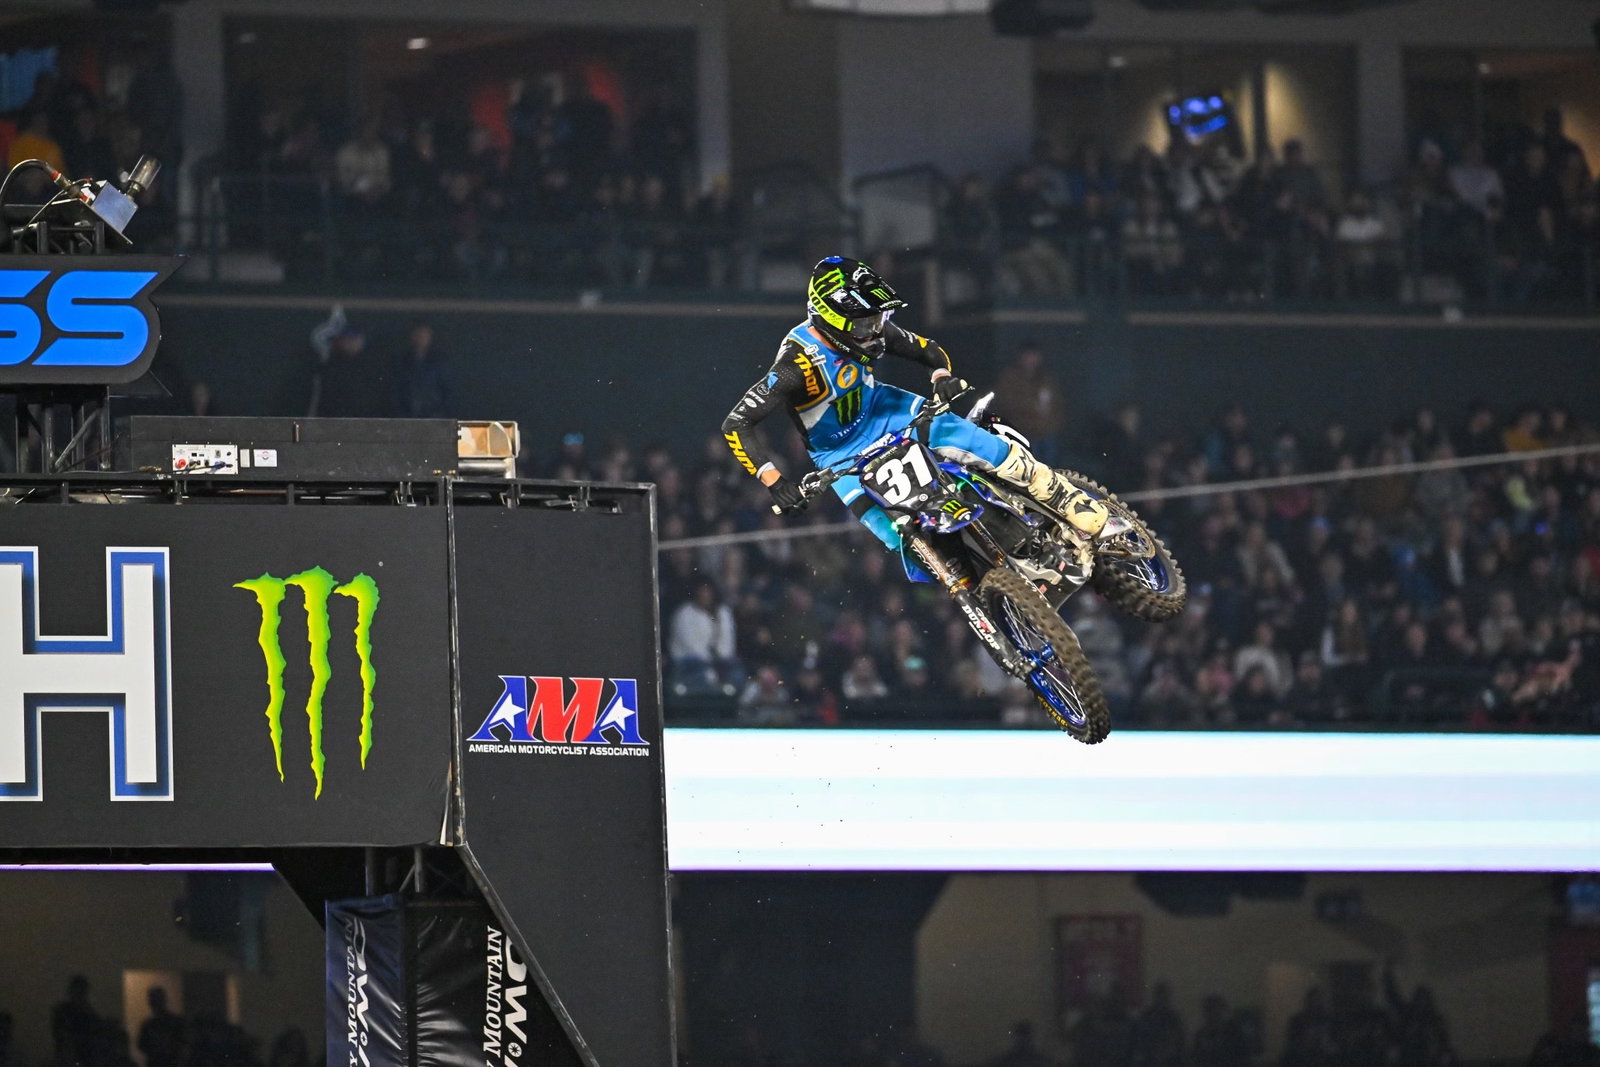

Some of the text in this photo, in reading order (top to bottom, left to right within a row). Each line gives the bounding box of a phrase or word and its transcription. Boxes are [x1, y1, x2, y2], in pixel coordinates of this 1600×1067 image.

[794, 352, 820, 397] THOR
[876, 443, 933, 506] 31
[961, 604, 1001, 651] DUNLOP
[0, 546, 174, 802] H
[465, 674, 651, 746] AMA
[468, 743, 650, 757] AMERICAN MOTORCYCLIST ASSOCIATION
[344, 917, 358, 1048] MOUNTAIN
[483, 924, 503, 1058] MOUNTAIN
